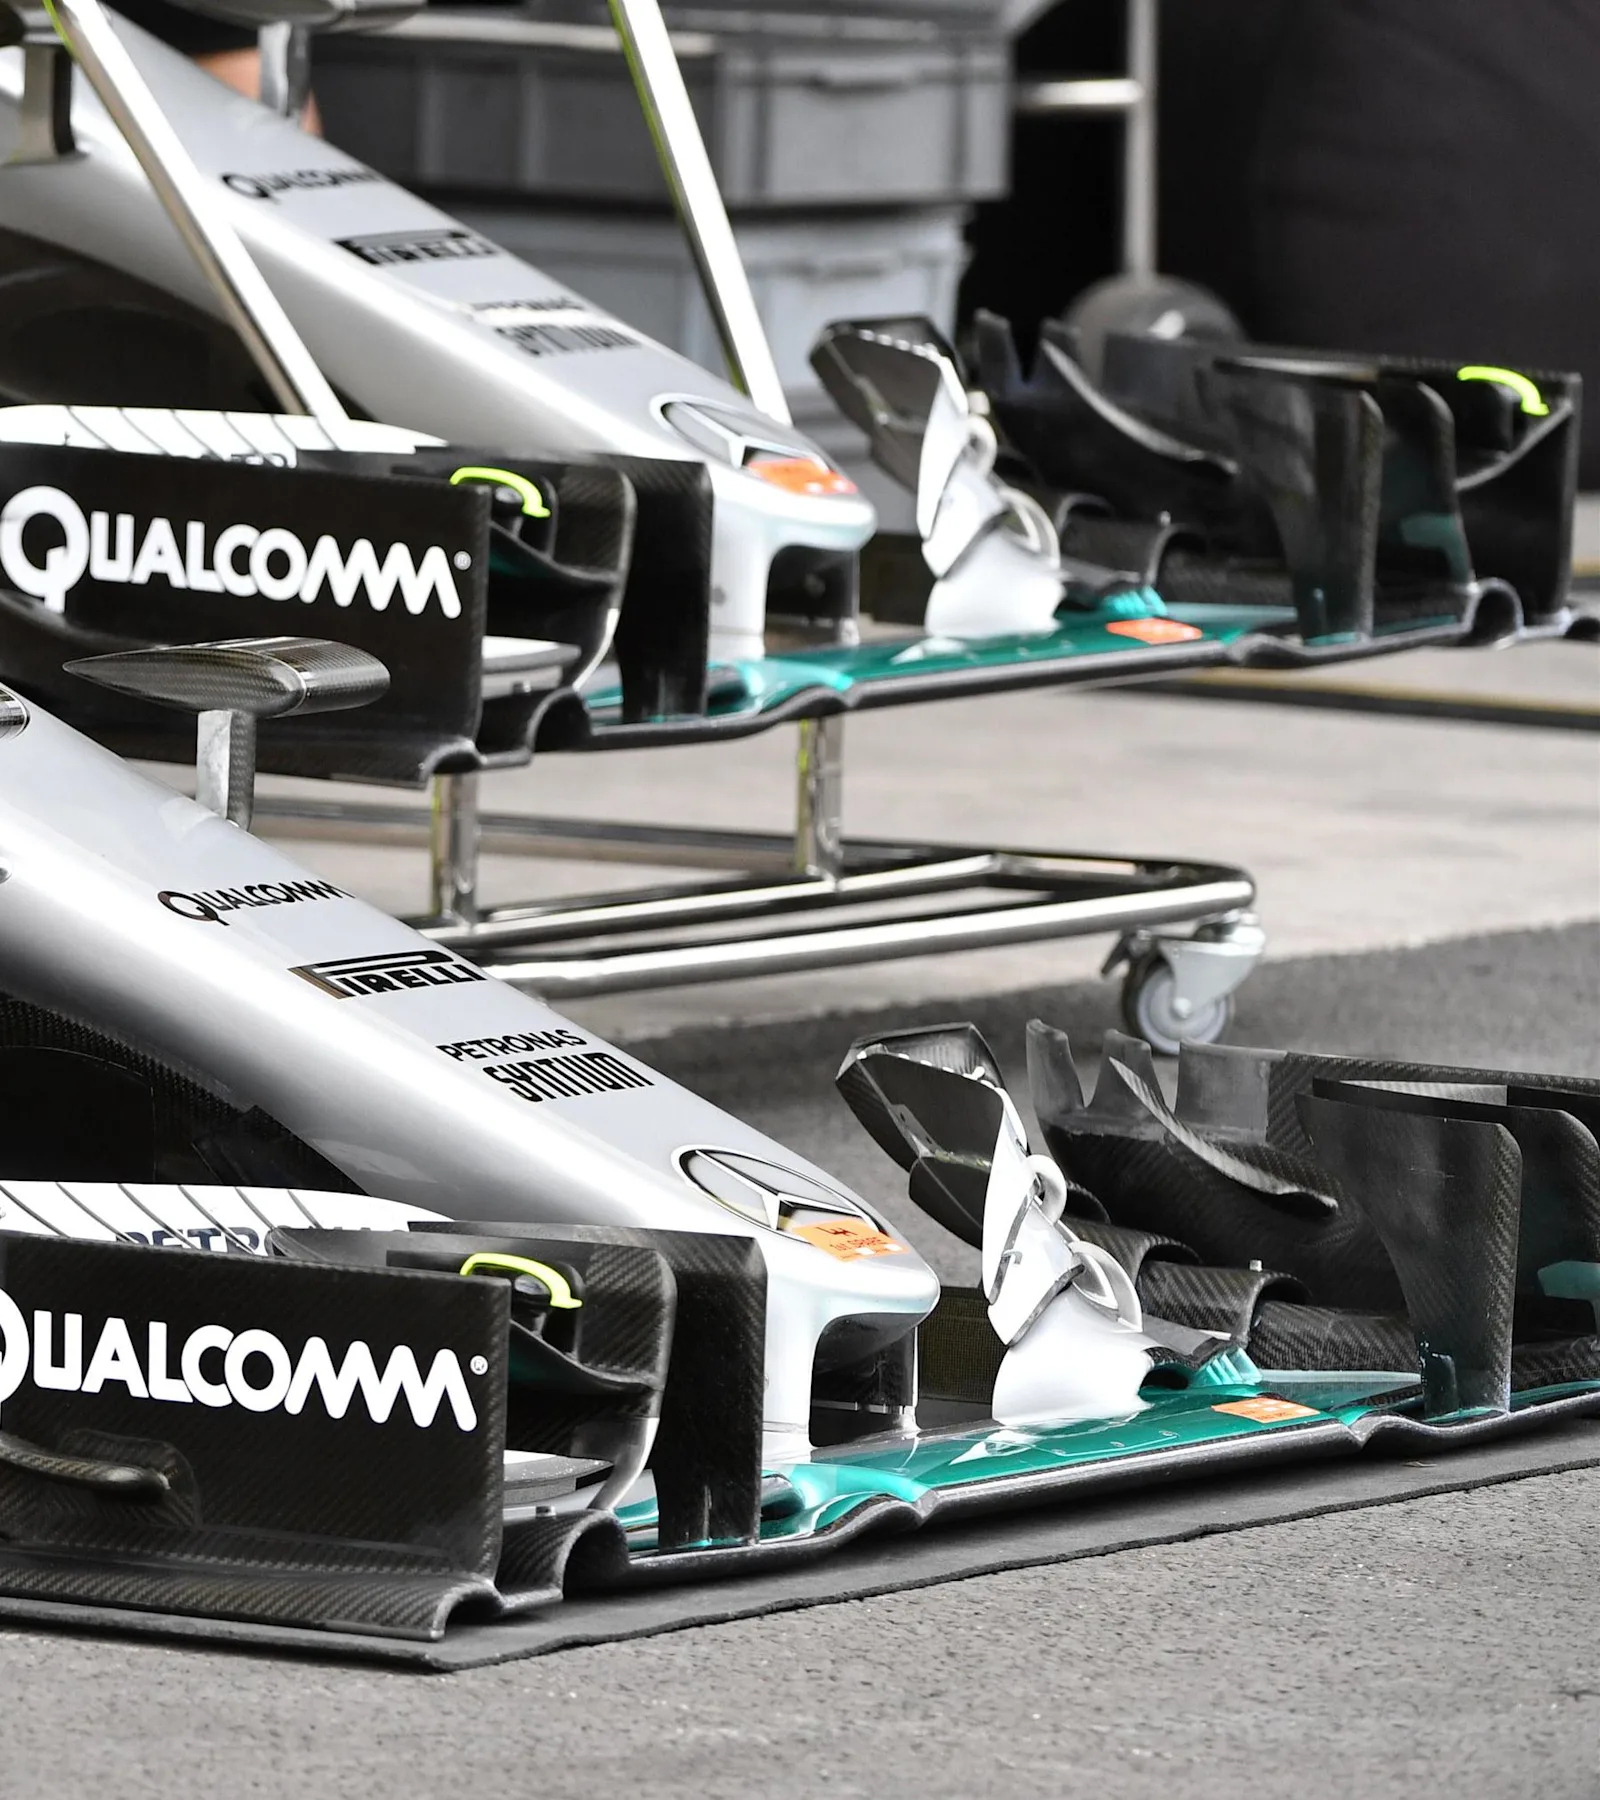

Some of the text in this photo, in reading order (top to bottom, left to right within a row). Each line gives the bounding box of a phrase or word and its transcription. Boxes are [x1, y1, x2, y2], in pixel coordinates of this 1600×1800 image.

[157, 880, 355, 926] QUALCOMM
[289, 950, 488, 999] PIRELLI
[436, 1029, 588, 1062] PETRONAS
[483, 1052, 655, 1103] SYNTIUM
